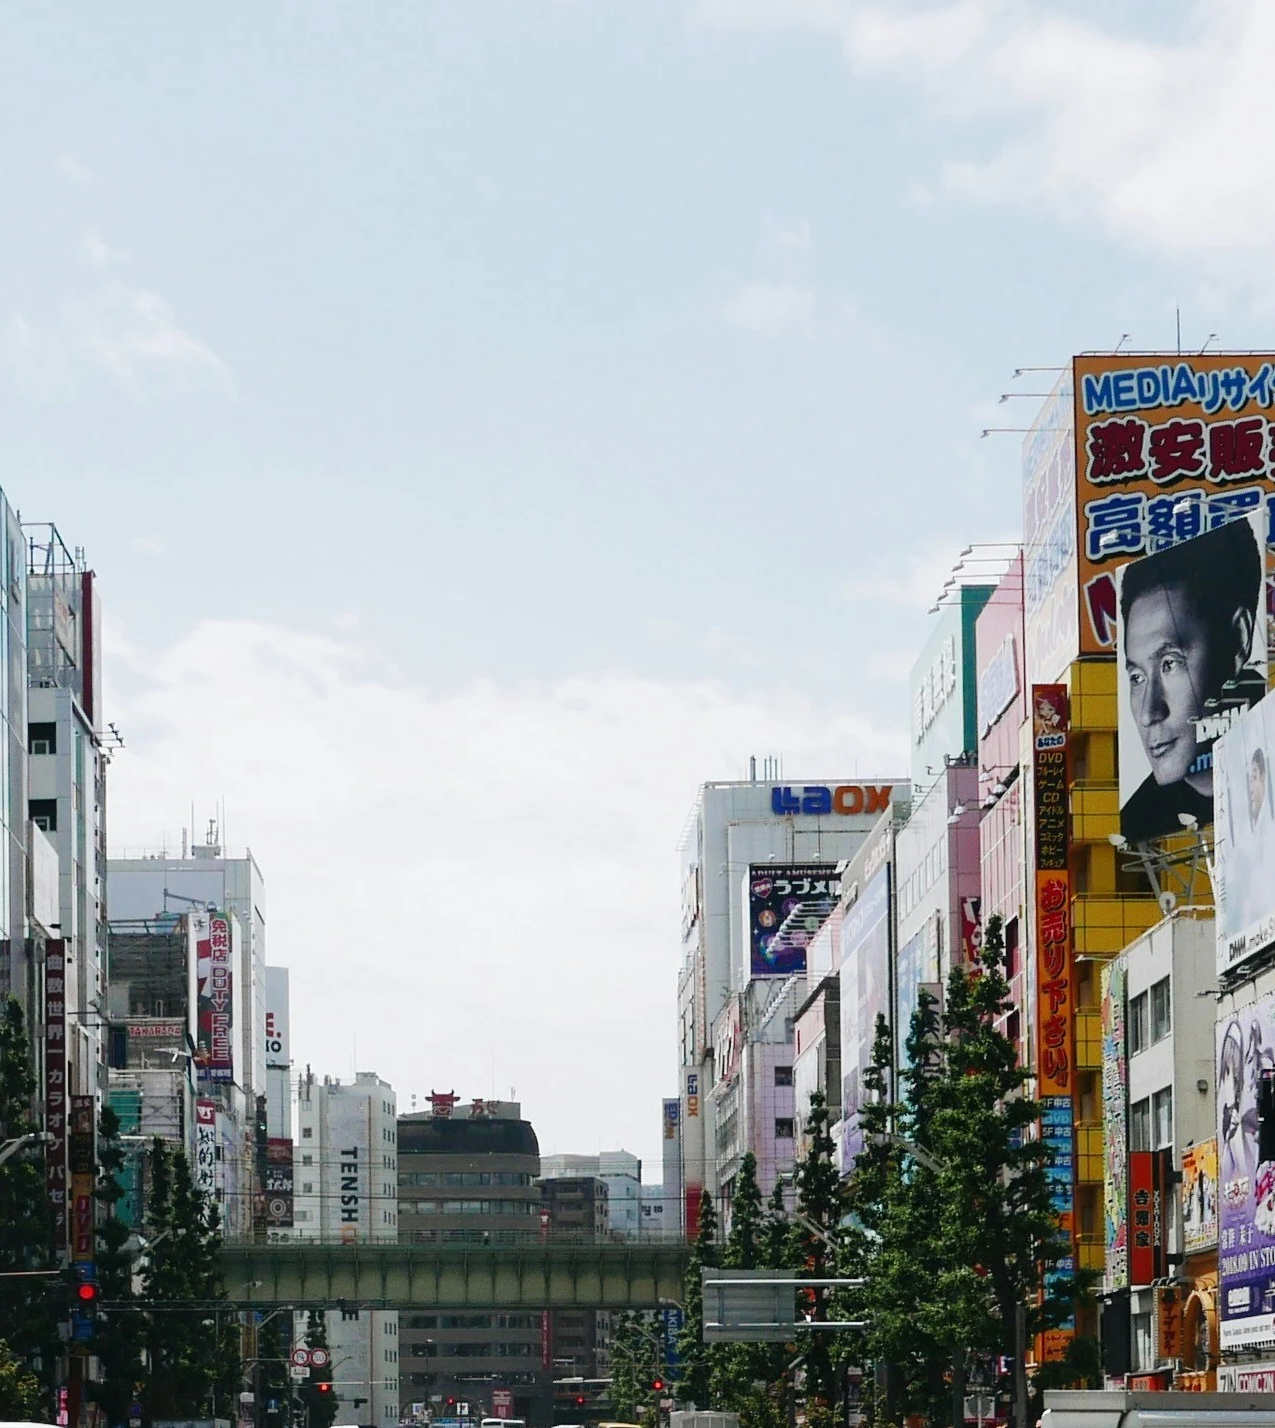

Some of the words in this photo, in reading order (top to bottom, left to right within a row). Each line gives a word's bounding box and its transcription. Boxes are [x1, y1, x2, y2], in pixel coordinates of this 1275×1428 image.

[1038, 752, 1063, 763] DVD
[1042, 792, 1060, 803] CD
[1038, 818, 1065, 829] アニメ
